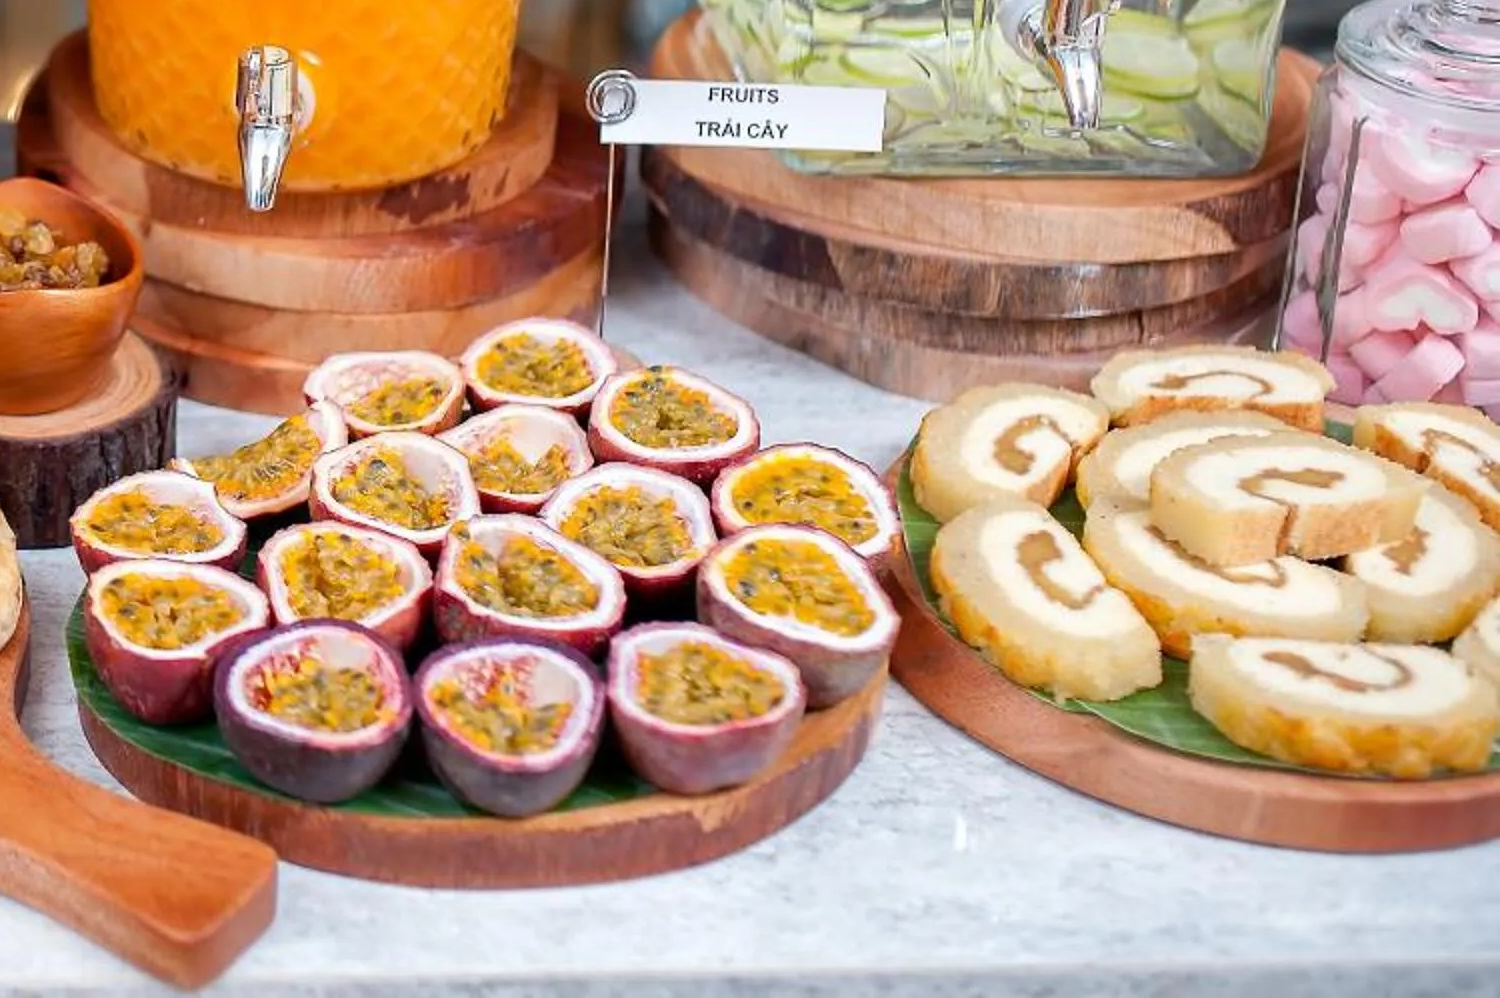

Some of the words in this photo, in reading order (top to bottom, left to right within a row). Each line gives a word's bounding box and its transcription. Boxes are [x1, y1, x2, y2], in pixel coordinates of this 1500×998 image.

[707, 86, 780, 104] FRUITS
[695, 117, 741, 138] TRÁI
[747, 118, 789, 140] CÂY
